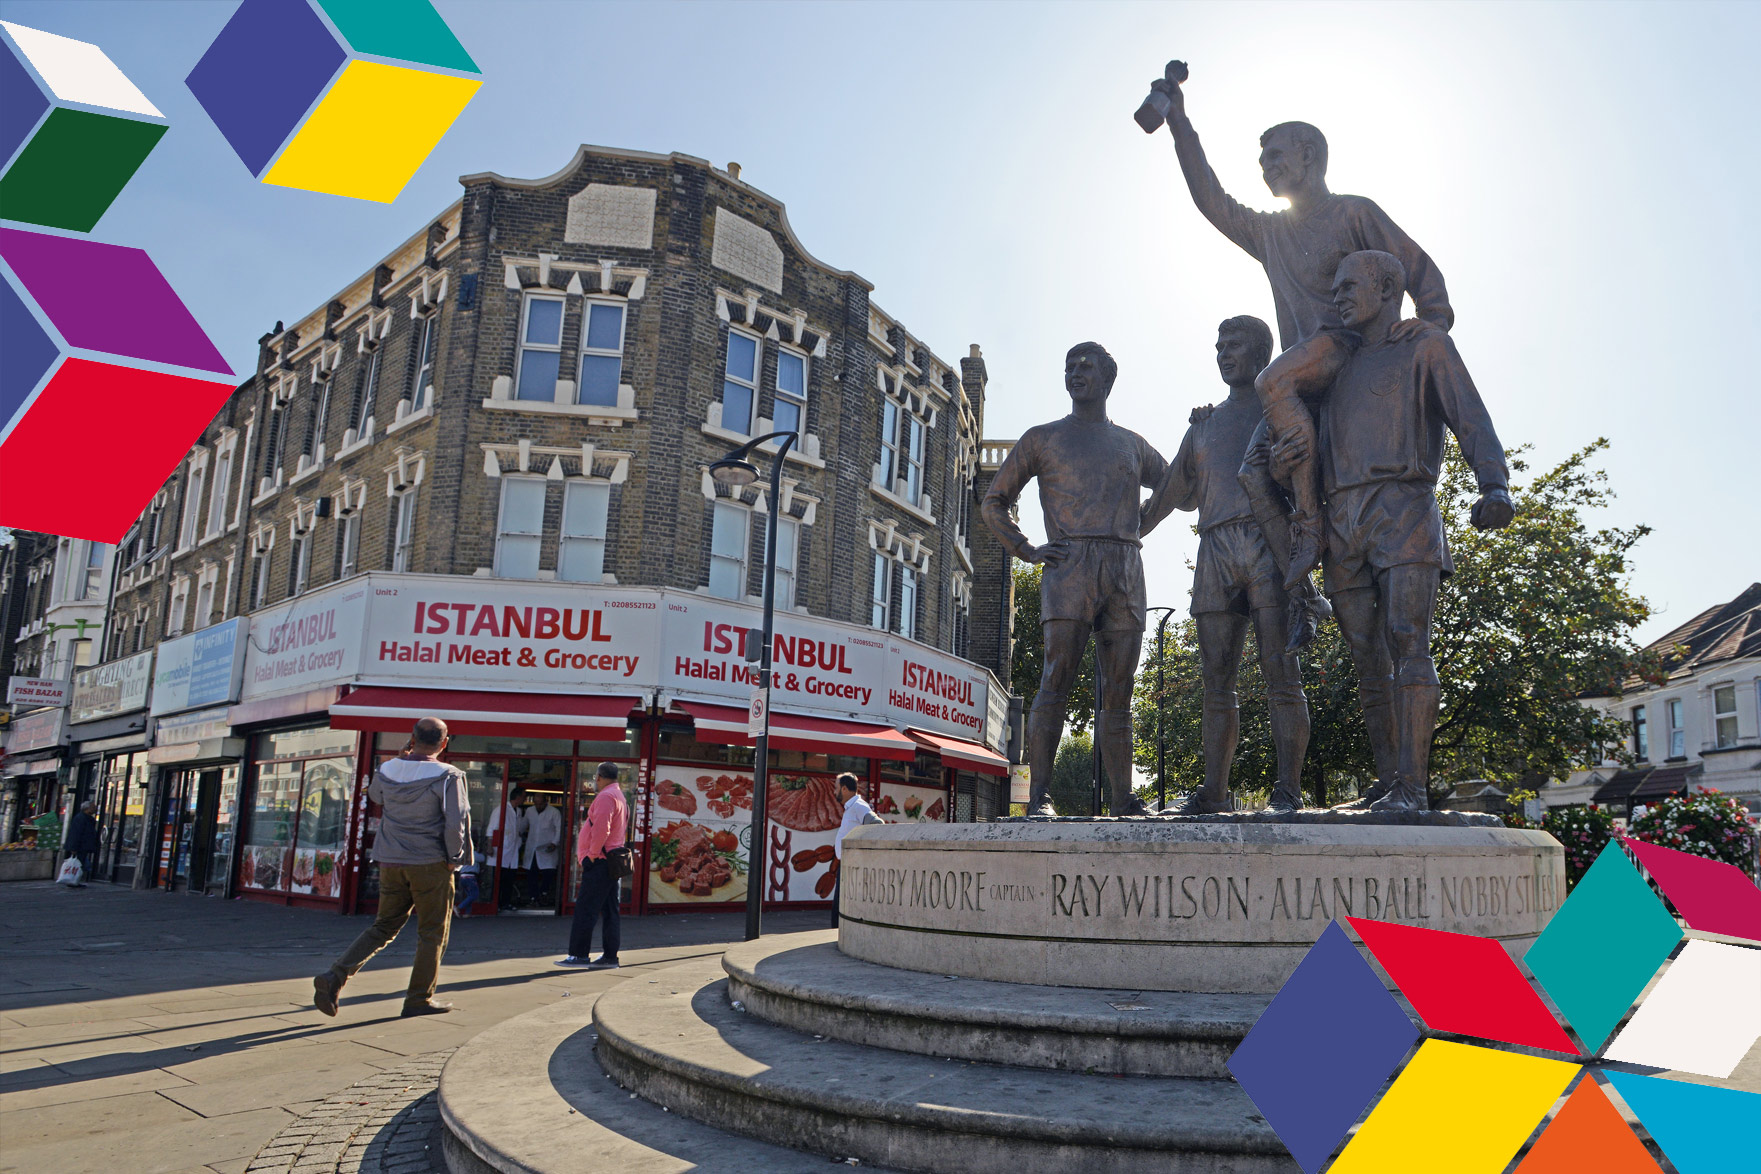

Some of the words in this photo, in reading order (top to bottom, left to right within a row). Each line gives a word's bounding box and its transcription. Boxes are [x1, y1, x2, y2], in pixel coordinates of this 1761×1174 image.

[375, 588, 392, 597] Unit
[392, 589, 399, 597] 2
[611, 601, 656, 610] 02085521123
[668, 603, 683, 612] Unit
[203, 627, 236, 650] INFINITY
[267, 608, 336, 657] ISTANBUL
[413, 601, 612, 643] ISTANBUL
[254, 660, 275, 684] Halal
[275, 656, 297, 679] Meat
[298, 654, 306, 674] &
[307, 647, 345, 671] Grocery
[379, 640, 441, 664] Halal
[447, 644, 512, 667] Meat
[516, 647, 538, 668] &
[543, 648, 640, 678] Grocery
[703, 620, 853, 674] ISTNBUL
[13, 687, 35, 695] FISH
[35, 688, 63, 698] BAZAR
[674, 655, 726, 682] Halal
[731, 663, 782, 690] Met
[784, 672, 801, 692] &
[807, 675, 872, 706] Grocery
[902, 659, 975, 708] ISTANBUL
[888, 688, 914, 712] Halal
[915, 697, 941, 719] Meat
[941, 705, 950, 721] &
[951, 707, 984, 734] Grocery
[861, 867, 908, 906] BOBBY
[909, 870, 986, 912] MOORE
[990, 883, 1036, 903] CAPTAIN
[1051, 873, 1109, 917] RAY
[1116, 874, 1250, 920] WILSON
[1270, 876, 1353, 921] ALAN
[1363, 877, 1430, 921] BALL
[1440, 875, 1512, 918] NOBBY
[1515, 874, 1553, 914] STILES
